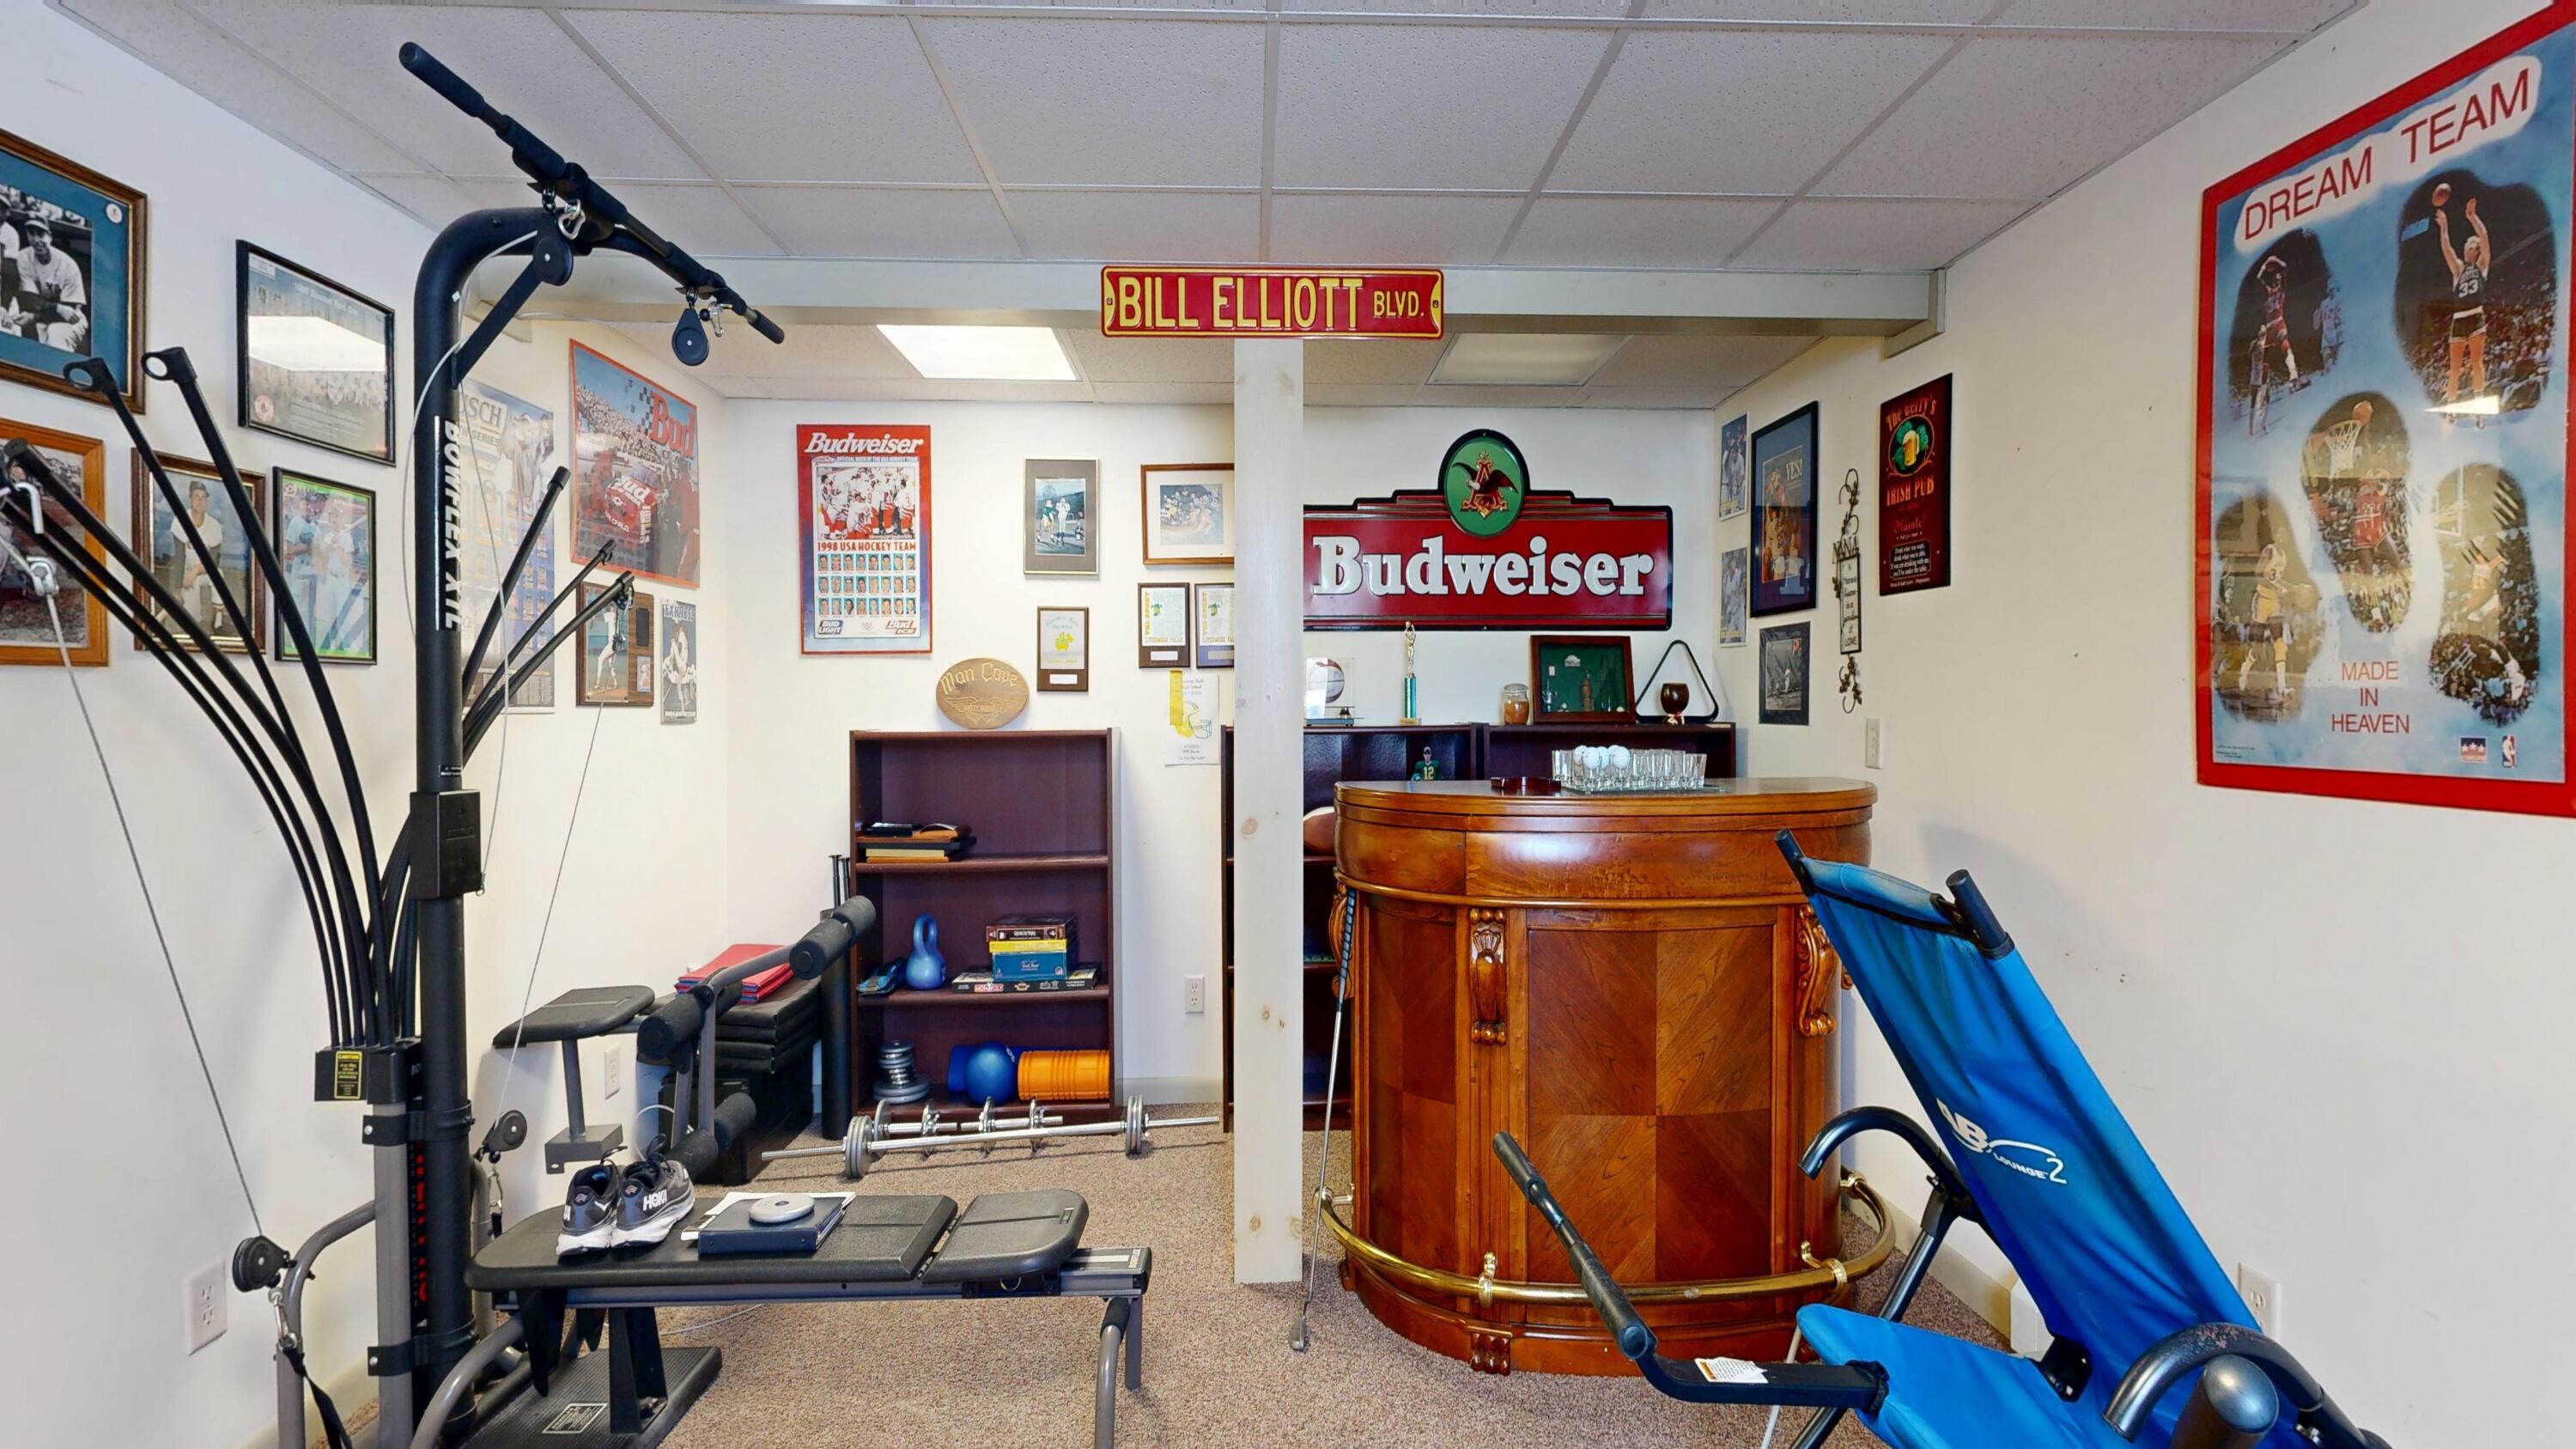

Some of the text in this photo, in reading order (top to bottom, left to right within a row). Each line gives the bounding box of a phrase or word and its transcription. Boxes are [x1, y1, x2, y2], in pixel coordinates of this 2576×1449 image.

[2244, 68, 2530, 240] DREAM TEAM
[2458, 279, 2478, 298] 33
[1118, 276, 1425, 329] BILL ELLIOTT BLVD.
[650, 391, 696, 460] Bud
[804, 432, 925, 454] Budweiser
[1886, 476, 1935, 506] IRISH PUB
[817, 542, 916, 551] 1998 USA HOCKEY TEAM
[1311, 534, 1656, 596] Budweiser
[939, 661, 1018, 695] Man Cave
[2341, 660, 2398, 681] MADE
[2360, 688, 2379, 707] IN
[2331, 713, 2409, 734] HEAVEN
[1423, 767, 1435, 781] 12
[1993, 1152, 2046, 1179] LOUNGE
[643, 1189, 667, 1212] HOKA
